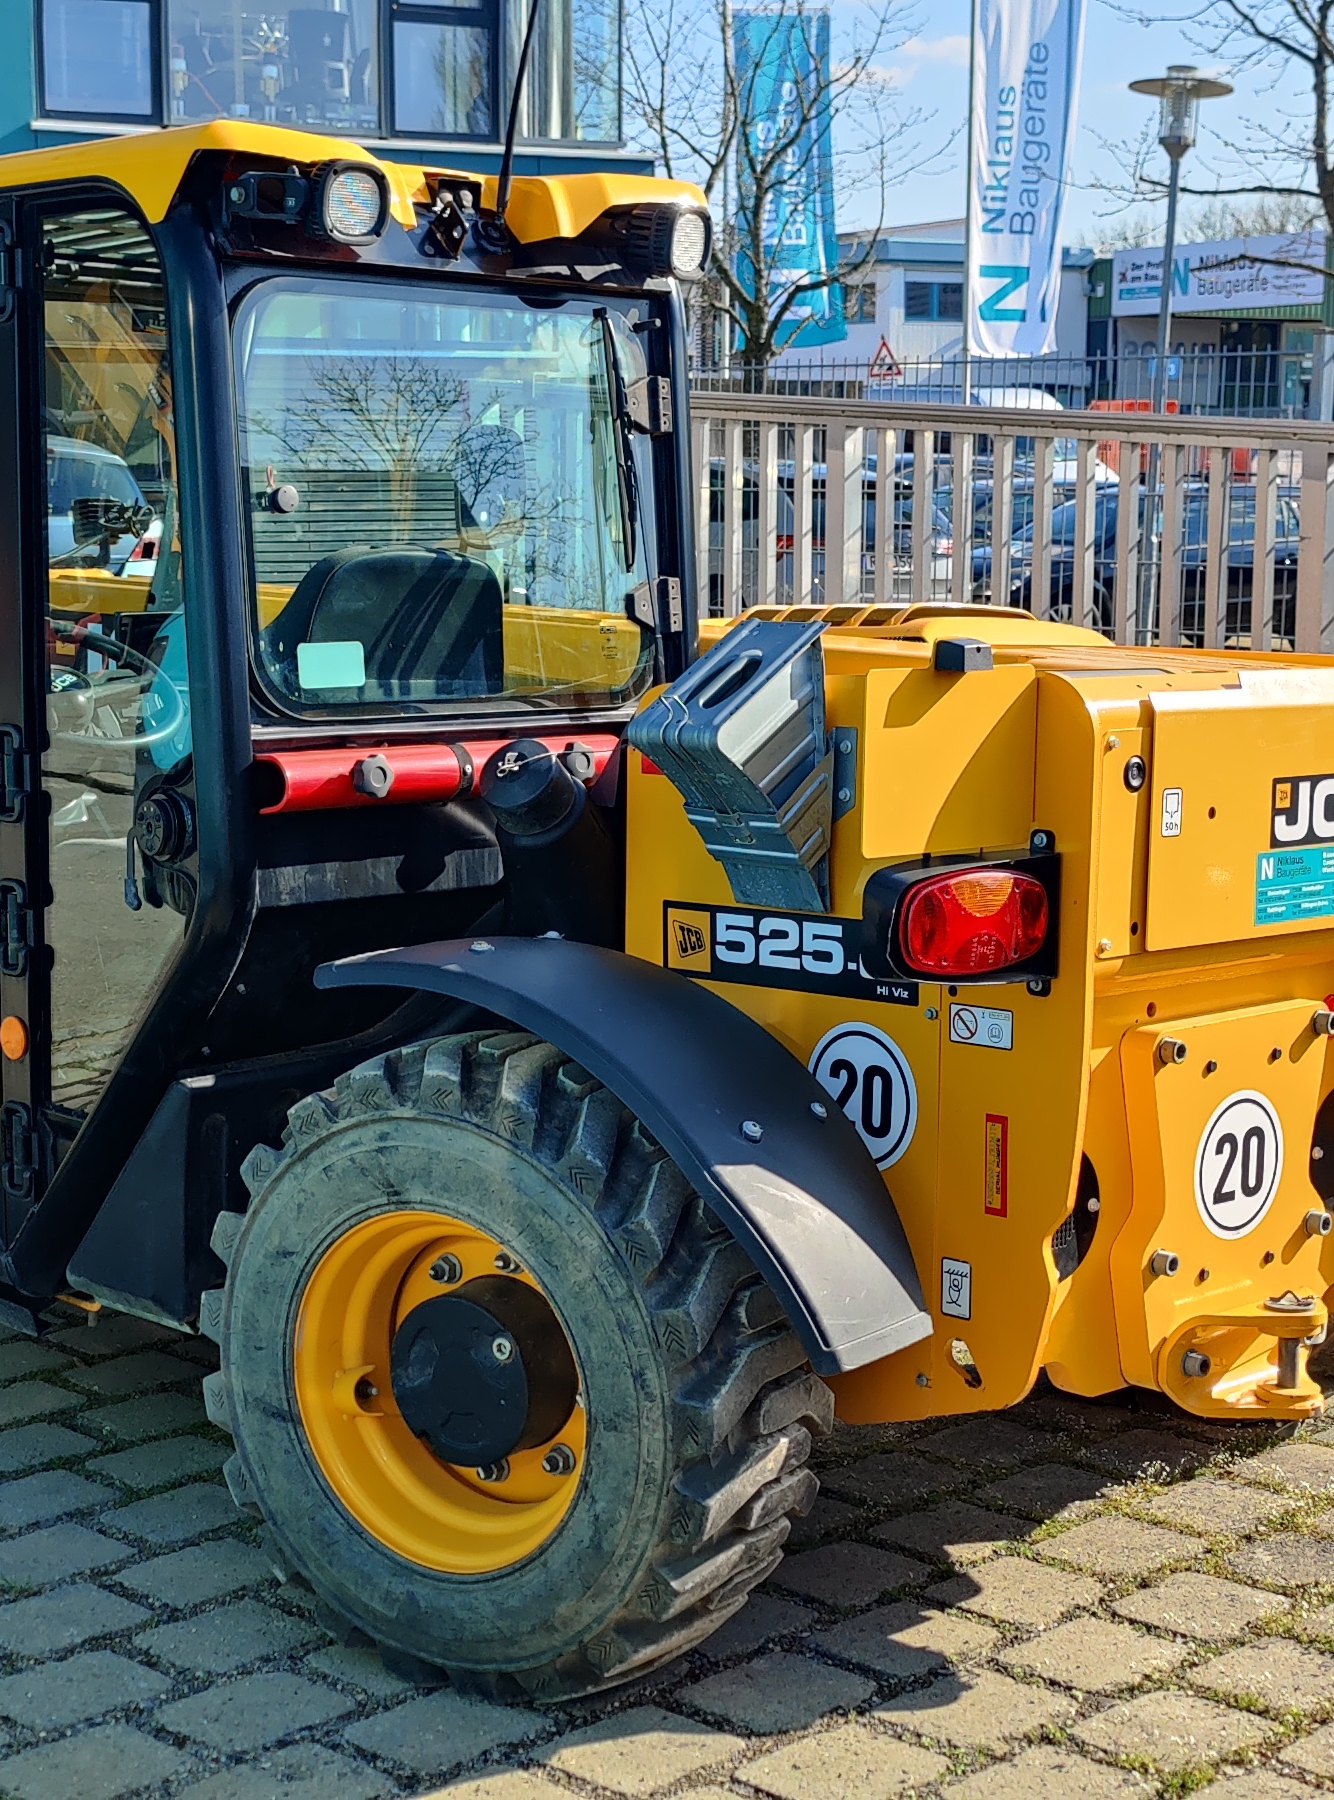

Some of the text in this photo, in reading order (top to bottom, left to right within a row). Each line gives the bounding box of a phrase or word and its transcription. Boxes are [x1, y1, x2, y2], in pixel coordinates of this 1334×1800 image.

[981, 85, 1017, 235] Niklaus
[1009, 42, 1051, 236] Baugeräte
[978, 264, 1031, 323] N
[1260, 856, 1274, 881] N
[1277, 855, 1304, 867] Niklaus
[678, 924, 705, 954] JCB
[715, 912, 875, 979] 525-
[876, 985, 909, 999] Hi Viz
[828, 1058, 893, 1139] 20
[1212, 1125, 1266, 1206] 20
